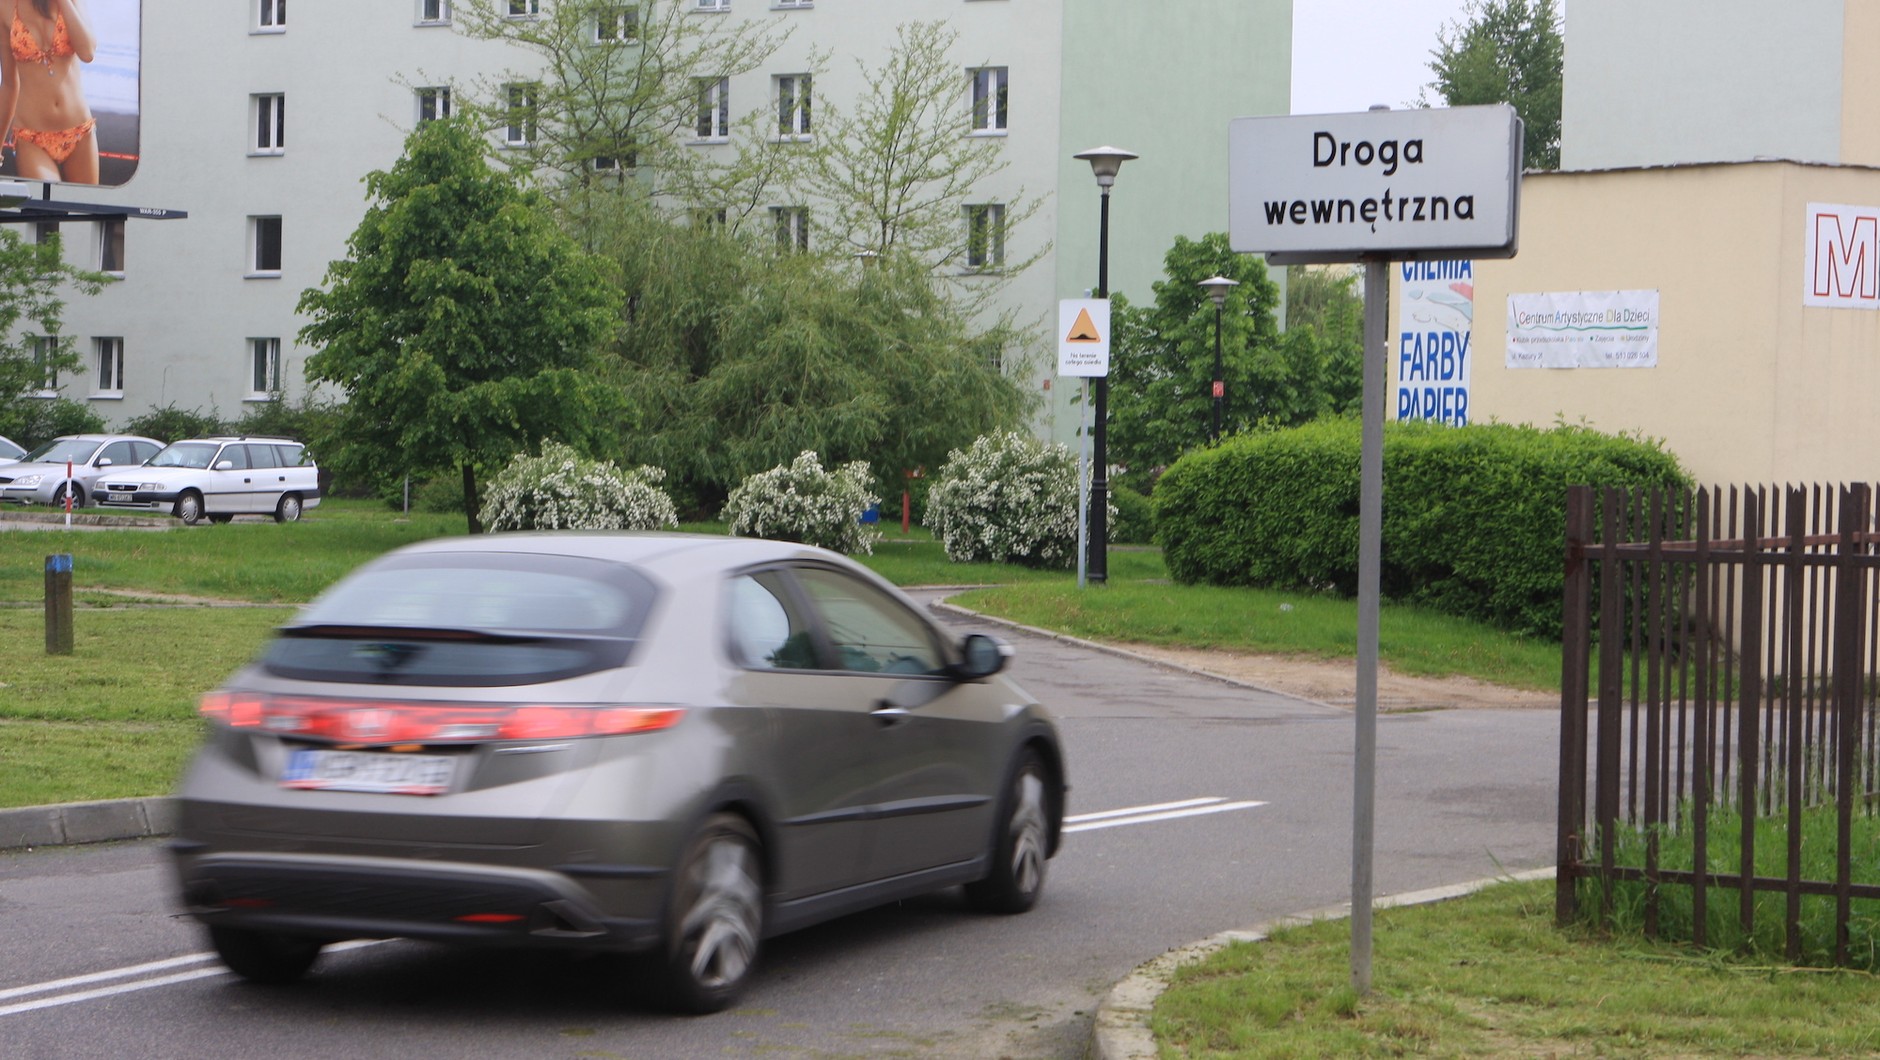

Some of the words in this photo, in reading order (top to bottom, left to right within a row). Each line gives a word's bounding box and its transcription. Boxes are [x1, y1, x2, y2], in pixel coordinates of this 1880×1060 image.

[1313, 131, 1423, 176] Droga
[1264, 187, 1474, 233] wewnętrzna
[1814, 213, 1880, 299] M
[1519, 311, 1554, 325] Centrum
[1554, 309, 1604, 327] Artystyczne
[1606, 308, 1622, 323] Dla
[1623, 307, 1650, 323] Dzieci
[1400, 331, 1470, 381] FARBY
[1398, 387, 1467, 428] PAPIER
